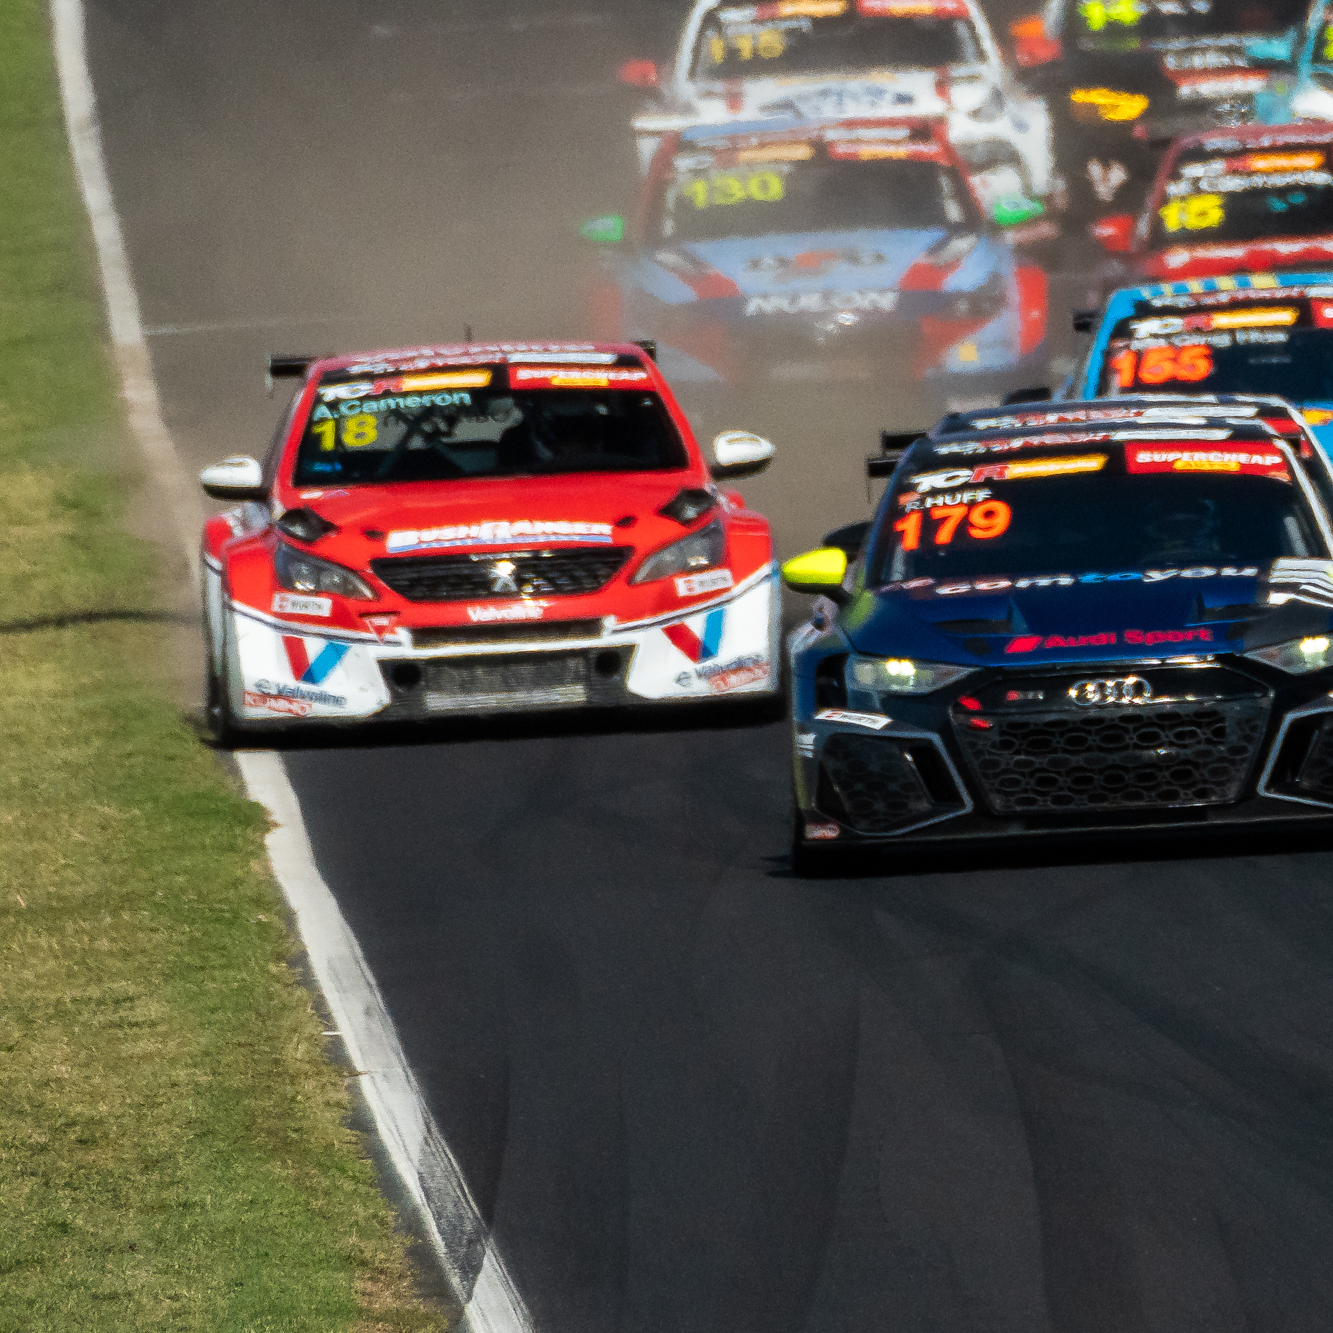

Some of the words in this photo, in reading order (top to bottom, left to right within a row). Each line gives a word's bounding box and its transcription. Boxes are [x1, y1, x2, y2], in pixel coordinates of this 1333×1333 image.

[312, 391, 473, 422] A.Cameron
[310, 416, 378, 451] 18
[1135, 450, 1284, 466] SUPERCHEAP
[910, 465, 1011, 493] TCR
[905, 489, 994, 513] R.HUFF
[893, 499, 1013, 552] 179
[1044, 632, 1117, 649] Audi
[1123, 629, 1213, 646] Sport
